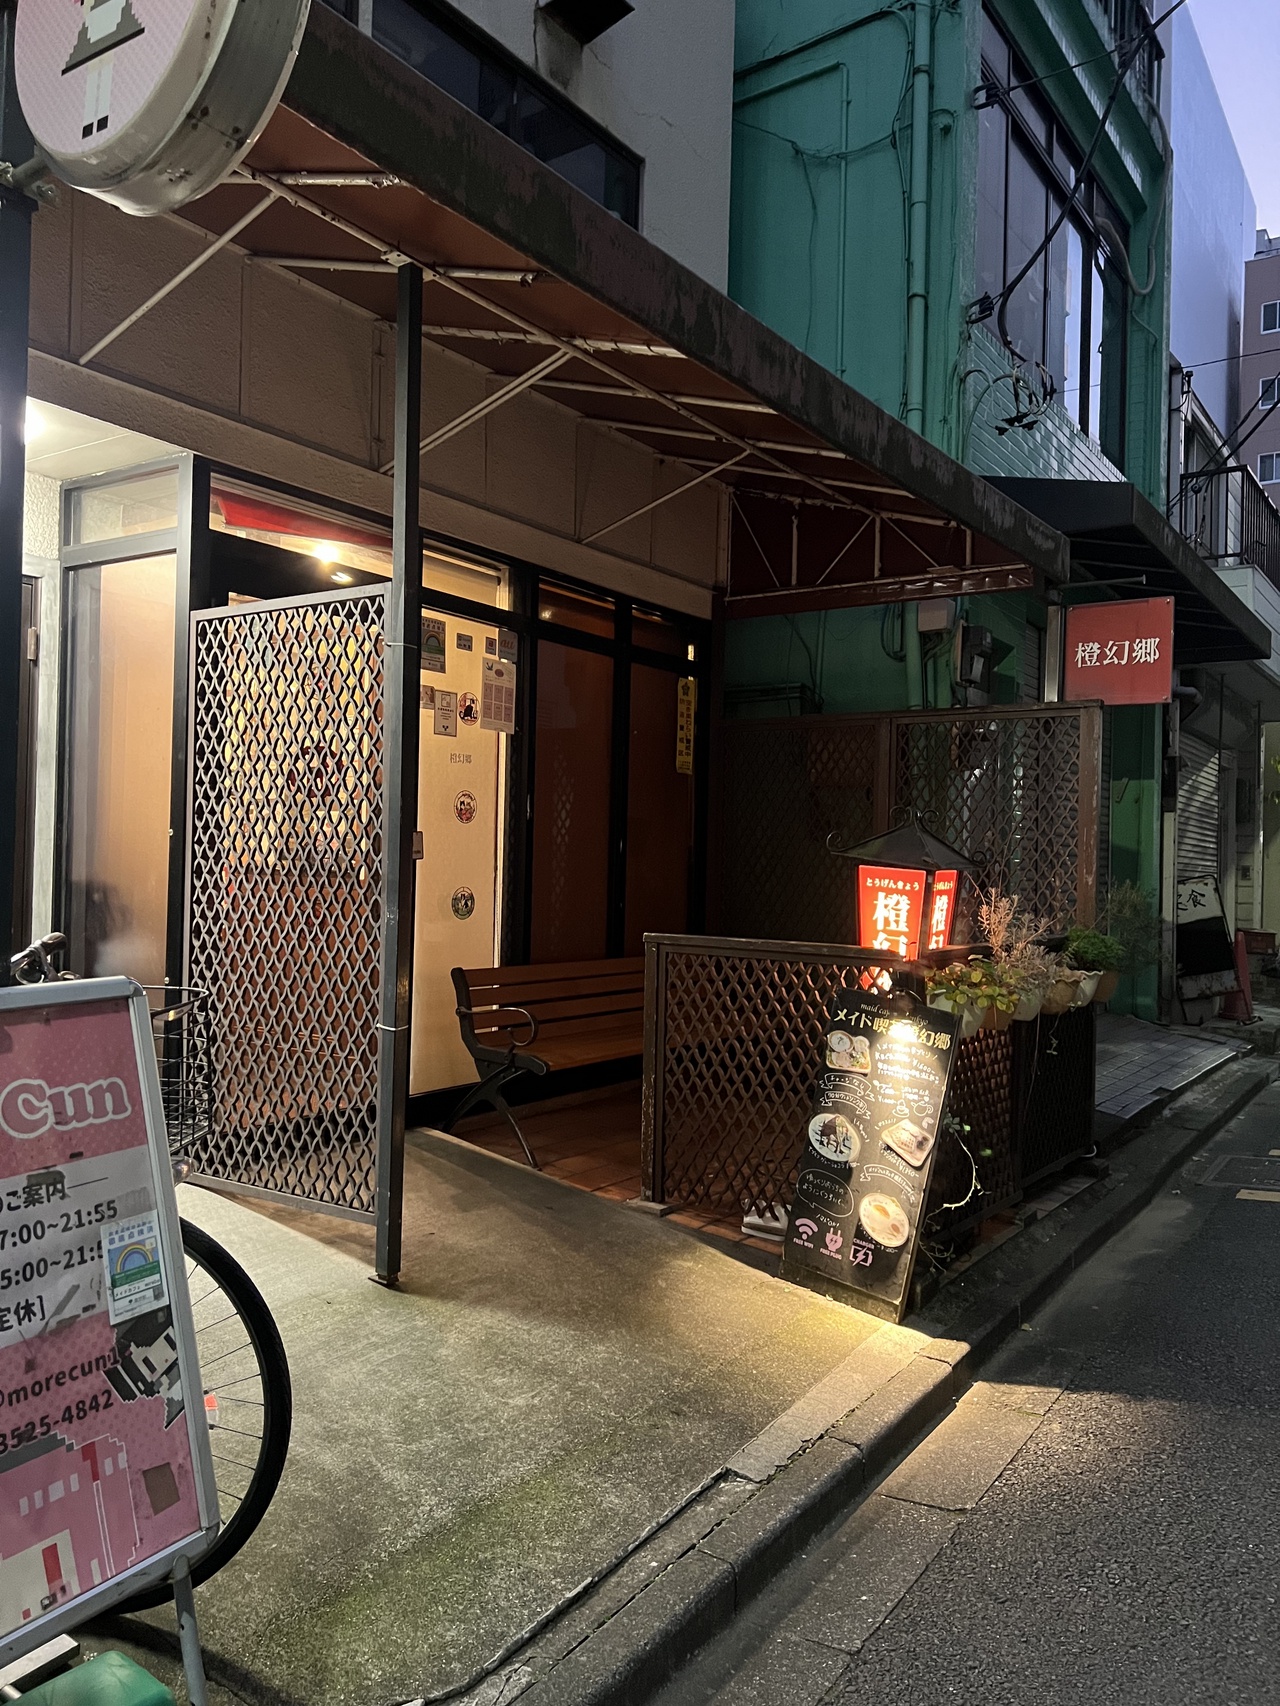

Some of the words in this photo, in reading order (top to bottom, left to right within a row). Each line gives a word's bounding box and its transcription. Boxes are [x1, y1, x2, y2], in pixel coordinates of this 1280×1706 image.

[1075, 637, 1160, 668] 橙幻郷
[866, 878, 919, 890] とうげんきょう
[834, 1008, 951, 1050] メイド喫幻郷
[0, 1077, 132, 1139] Cun
[0, 1182, 66, 1213] ご案内
[0, 1346, 120, 1407] morecun1
